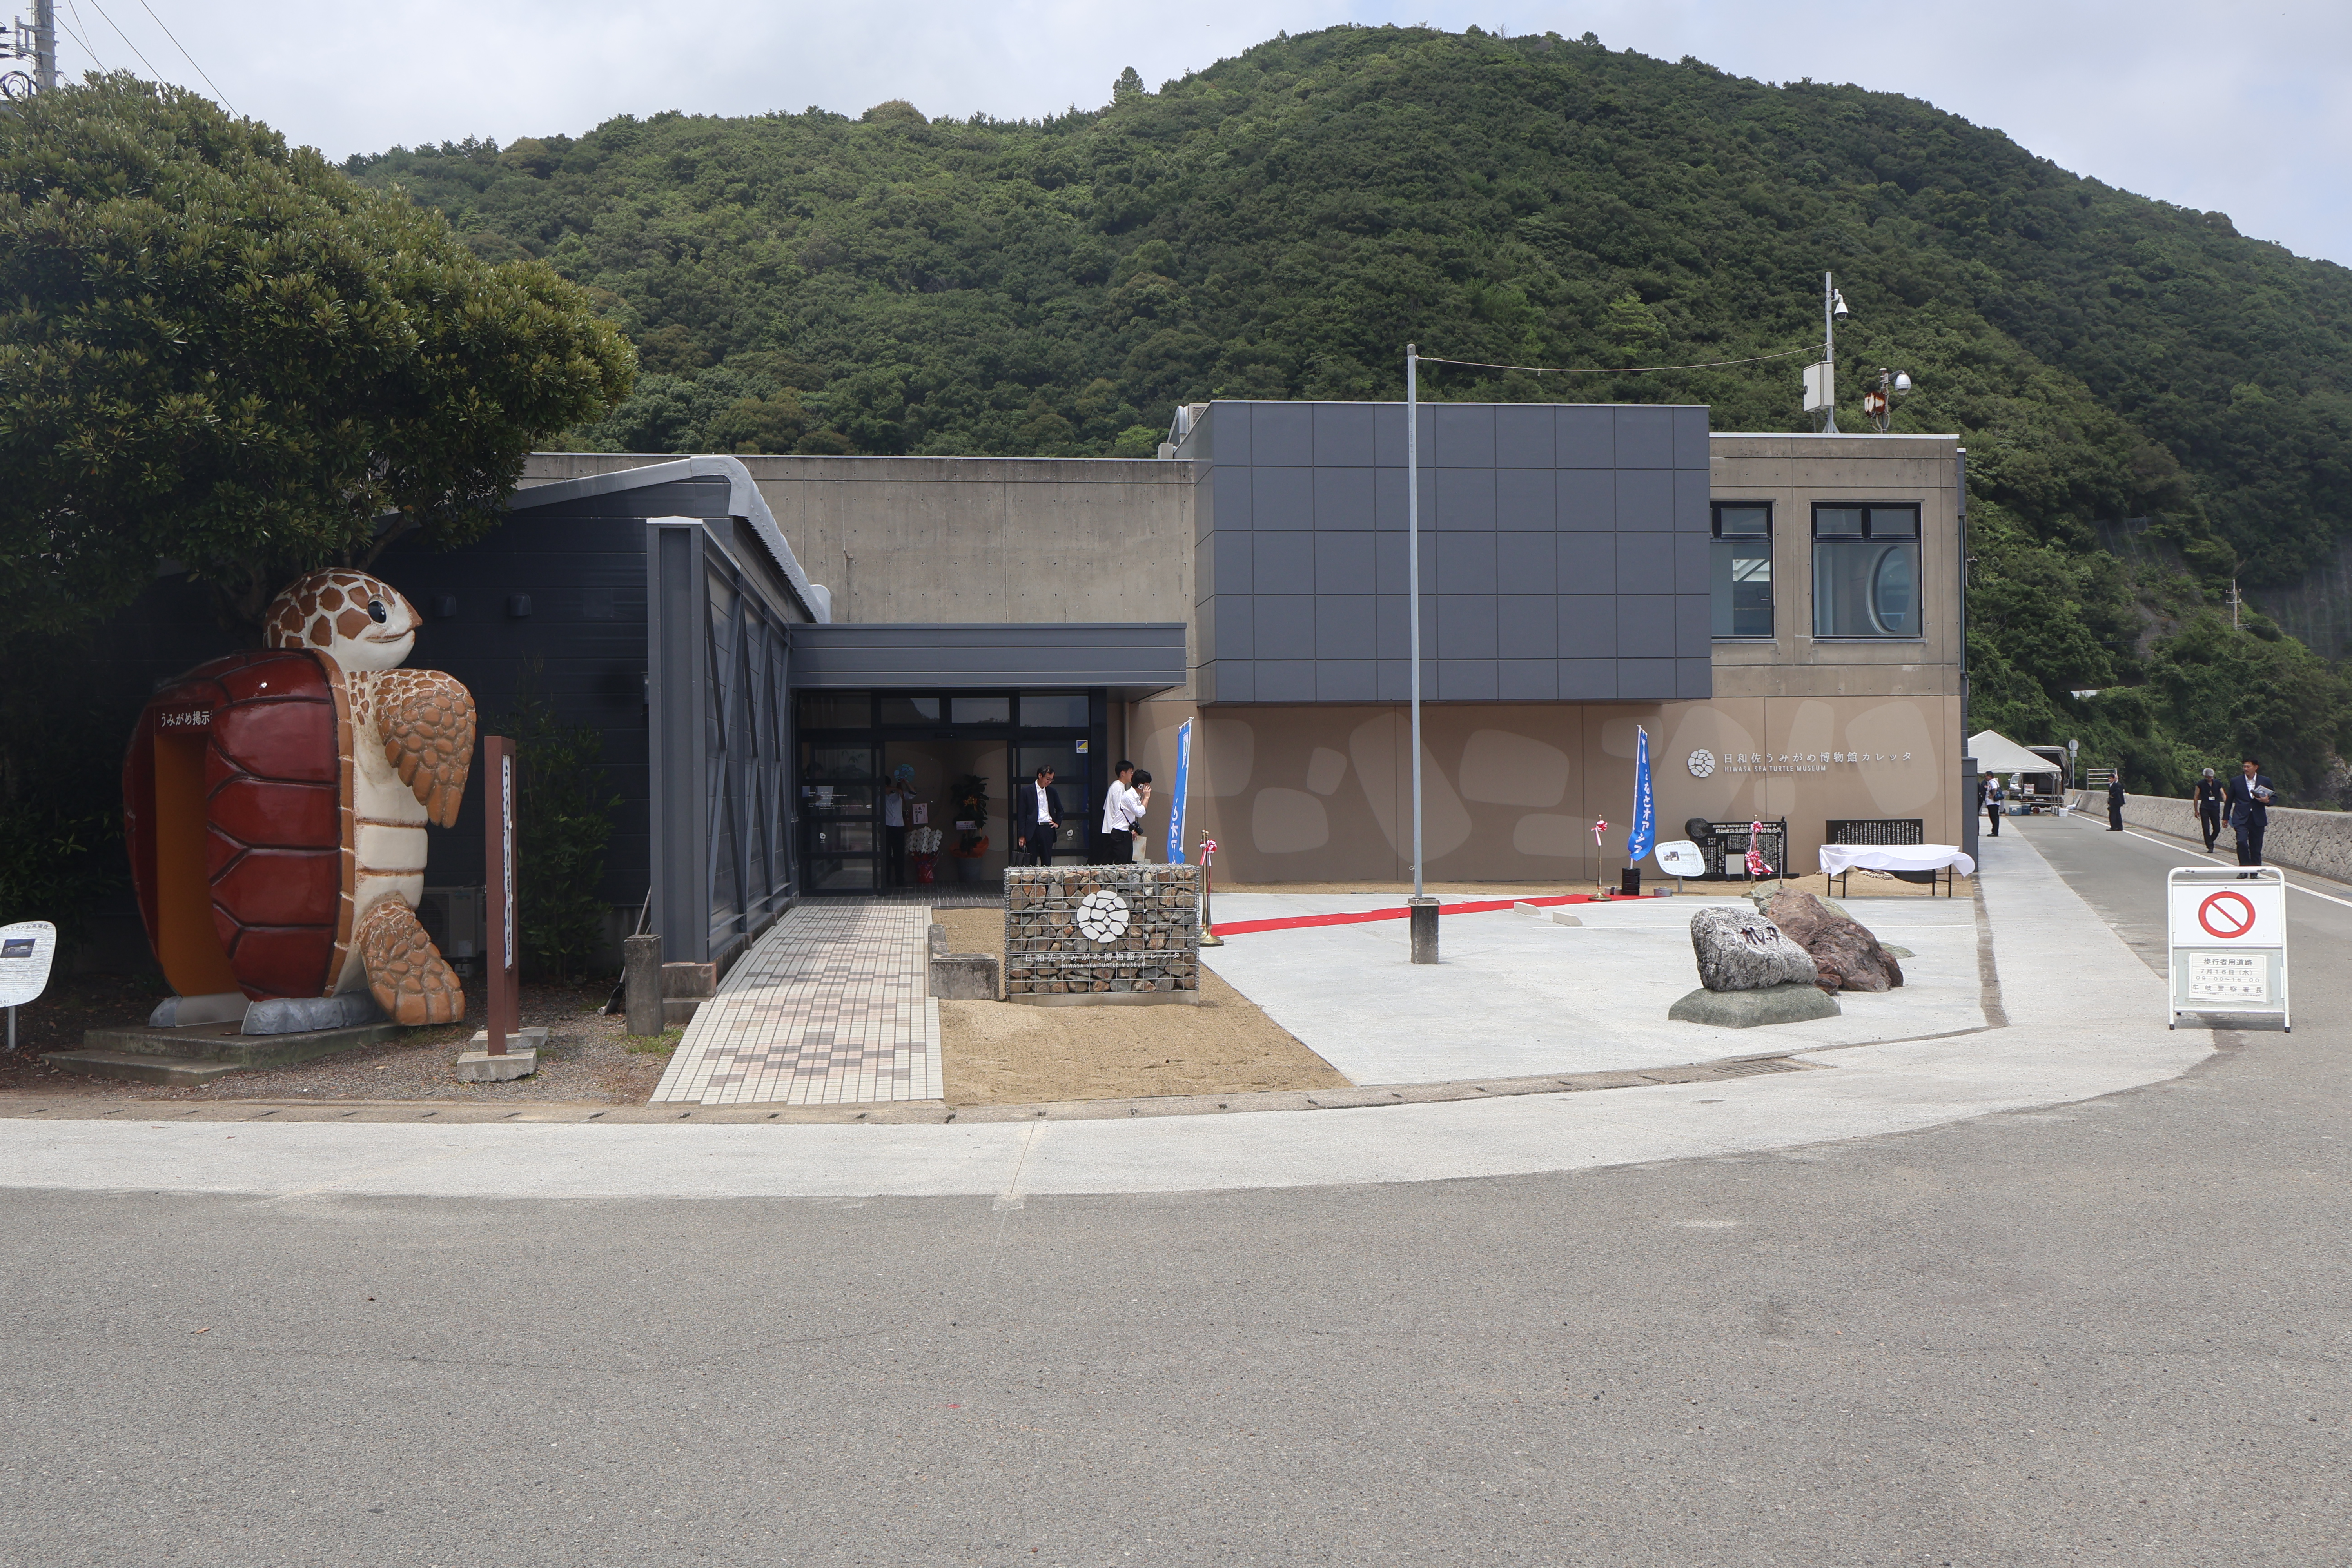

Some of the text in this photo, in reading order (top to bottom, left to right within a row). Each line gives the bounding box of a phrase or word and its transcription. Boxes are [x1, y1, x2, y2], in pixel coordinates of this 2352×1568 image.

[161, 710, 212, 727] うみがめ掲示
[1724, 752, 1911, 764] 日和佐うみがめ博物館カレッタ
[1025, 951, 1180, 962] 日和佐うみがめ博物館カレッタ
[2203, 958, 2252, 966] 歩行者用道路
[2192, 984, 2263, 993] 牟岐警察署長
